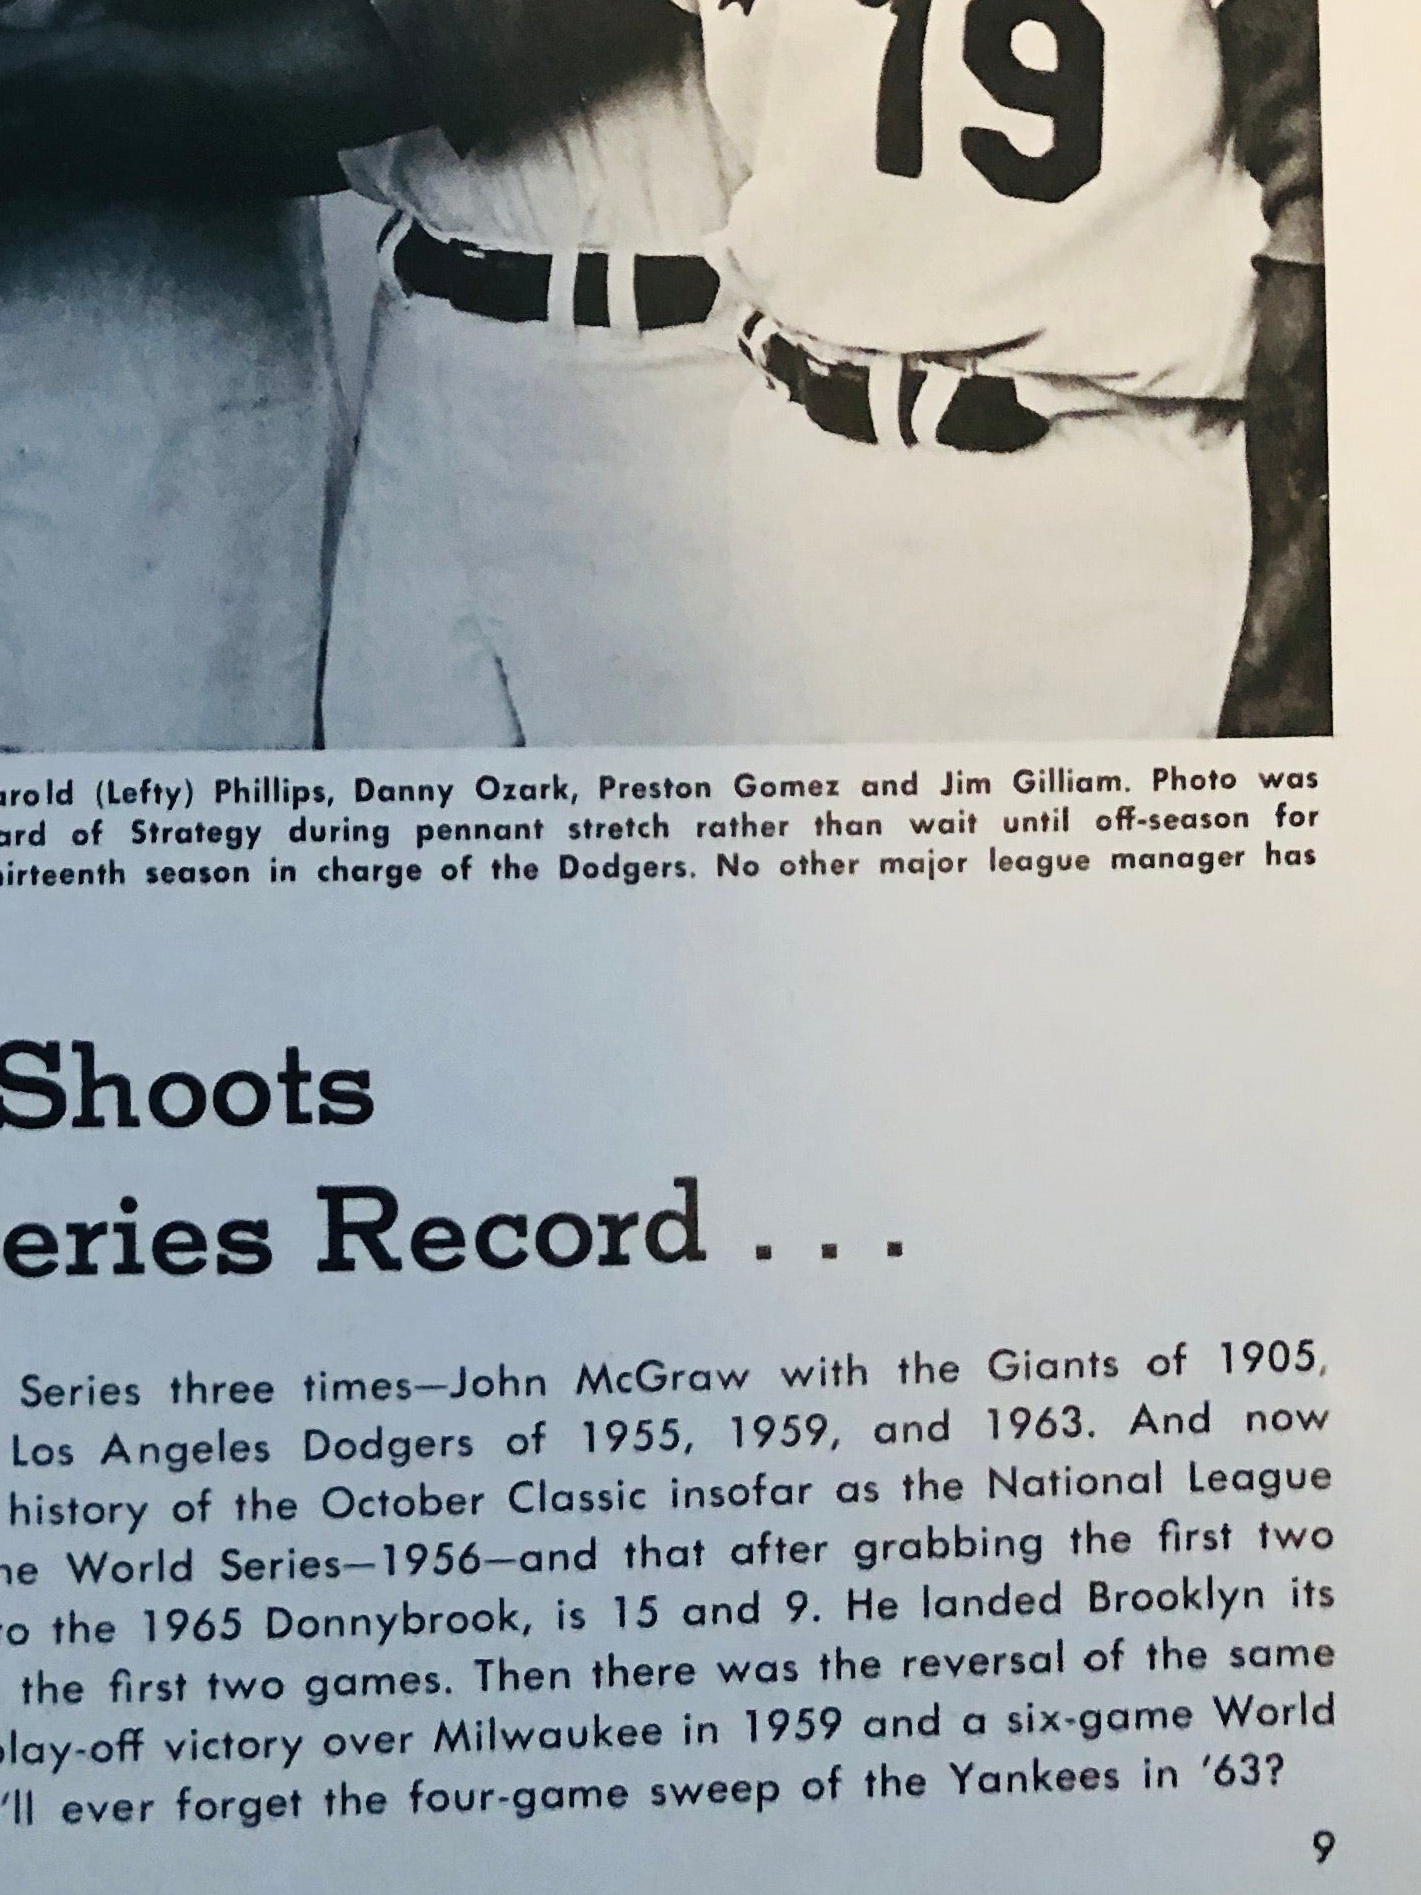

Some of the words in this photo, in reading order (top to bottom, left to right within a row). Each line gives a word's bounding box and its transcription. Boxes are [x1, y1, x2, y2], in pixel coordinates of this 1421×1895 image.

[96, 777, 194, 811] (Lefty)
[214, 775, 334, 811] Phillips,
[354, 776, 455, 810] Danny
[475, 772, 579, 806] Ozark,
[599, 774, 712, 800] Preston
[733, 771, 840, 799] Gomez
[861, 769, 918, 798] and
[939, 768, 992, 797] Jim
[1012, 766, 1131, 795] Gilliam.
[1152, 764, 1237, 792] Photo
[1257, 771, 1319, 790] was
[71, 818, 104, 847] of
[131, 818, 262, 851] Strategy
[288, 815, 390, 850] during
[416, 818, 545, 850] pennant
[568, 811, 670, 841] stretch
[696, 810, 790, 839] rather
[814, 809, 883, 837] than
[908, 808, 978, 835] wait
[1003, 805, 1069, 834] until
[1095, 804, 1249, 832] off-season
[1274, 800, 1320, 829] for
[145, 865, 250, 886] season
[270, 856, 297, 884] in
[317, 855, 423, 890] charge
[440, 853, 473, 882] of
[490, 852, 539, 881] the
[559, 851, 697, 886] Dodgers.
[716, 852, 760, 878] No
[779, 848, 860, 877] other
[879, 848, 968, 881] major
[989, 845, 1091, 879] league
[1110, 850, 1246, 875] manager
[1265, 839, 1317, 867] has
[317, 1177, 706, 1272] Record
[12, 1433, 75, 1468] Los
[99, 1427, 271, 1474] Angeles
[304, 1425, 474, 1469] Dodgers
[506, 1419, 547, 1457] of
[582, 1417, 694, 1456] 1955,
[731, 1412, 840, 1452] 1959,
[873, 1407, 950, 1445] and
[987, 1404, 1096, 1441] 1963.
[1128, 1399, 1211, 1436] And
[1245, 1408, 1330, 1434] now
[51, 1608, 116, 1646] the
[143, 1606, 242, 1643] 1965
[266, 1596, 532, 1647] Donnybrook,
[557, 1598, 586, 1631] is
[613, 1594, 658, 1630] 15
[682, 1589, 760, 1627] and
[785, 1589, 821, 1625] 9.
[847, 1587, 899, 1622] He
[922, 1579, 1062, 1620] landed
[1088, 1573, 1265, 1622] Brooklyn
[1291, 1575, 1335, 1609] its
[61, 1798, 155, 1826] ever
[175, 1785, 303, 1829] forget
[323, 1780, 388, 1818] the
[408, 1777, 629, 1820] four-game
[650, 1779, 780, 1814] sweep
[801, 1763, 843, 1802] of
[864, 1762, 927, 1799] the
[948, 1756, 1120, 1796] Yankees
[1143, 1756, 1178, 1790] in
[1202, 1751, 1284, 1788] '63?
[1313, 1829, 1336, 1864] 9
